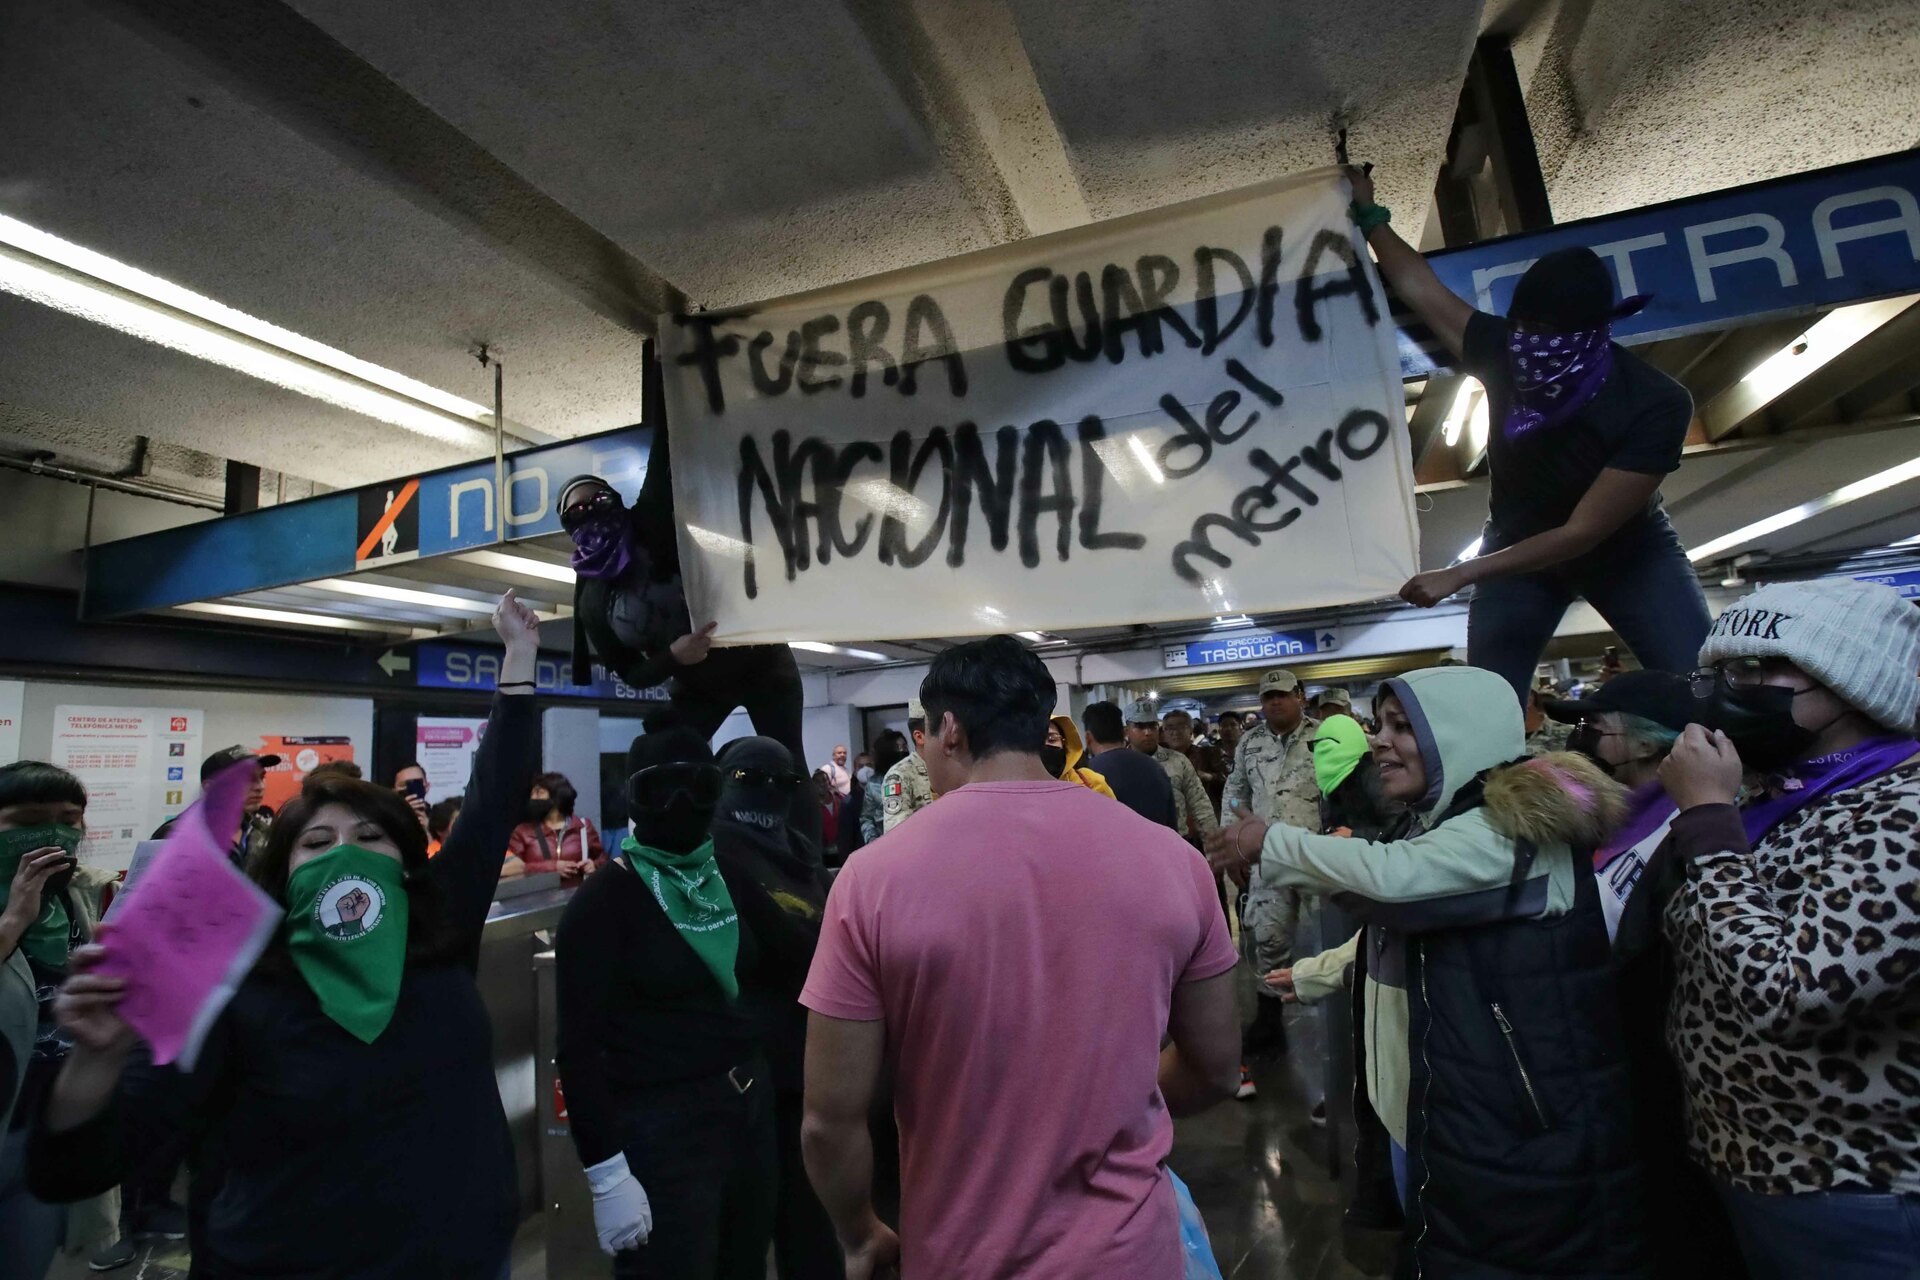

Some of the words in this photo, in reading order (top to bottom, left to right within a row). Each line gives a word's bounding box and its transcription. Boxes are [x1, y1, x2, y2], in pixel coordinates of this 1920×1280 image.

[677, 294, 968, 415] FUERA
[1000, 225, 1381, 375] GUARDIA
[737, 414, 1147, 600] NACIONAL
[1157, 358, 1284, 482] del
[1171, 408, 1390, 584] metro
[1200, 640, 1304, 663] TASQUEÑA
